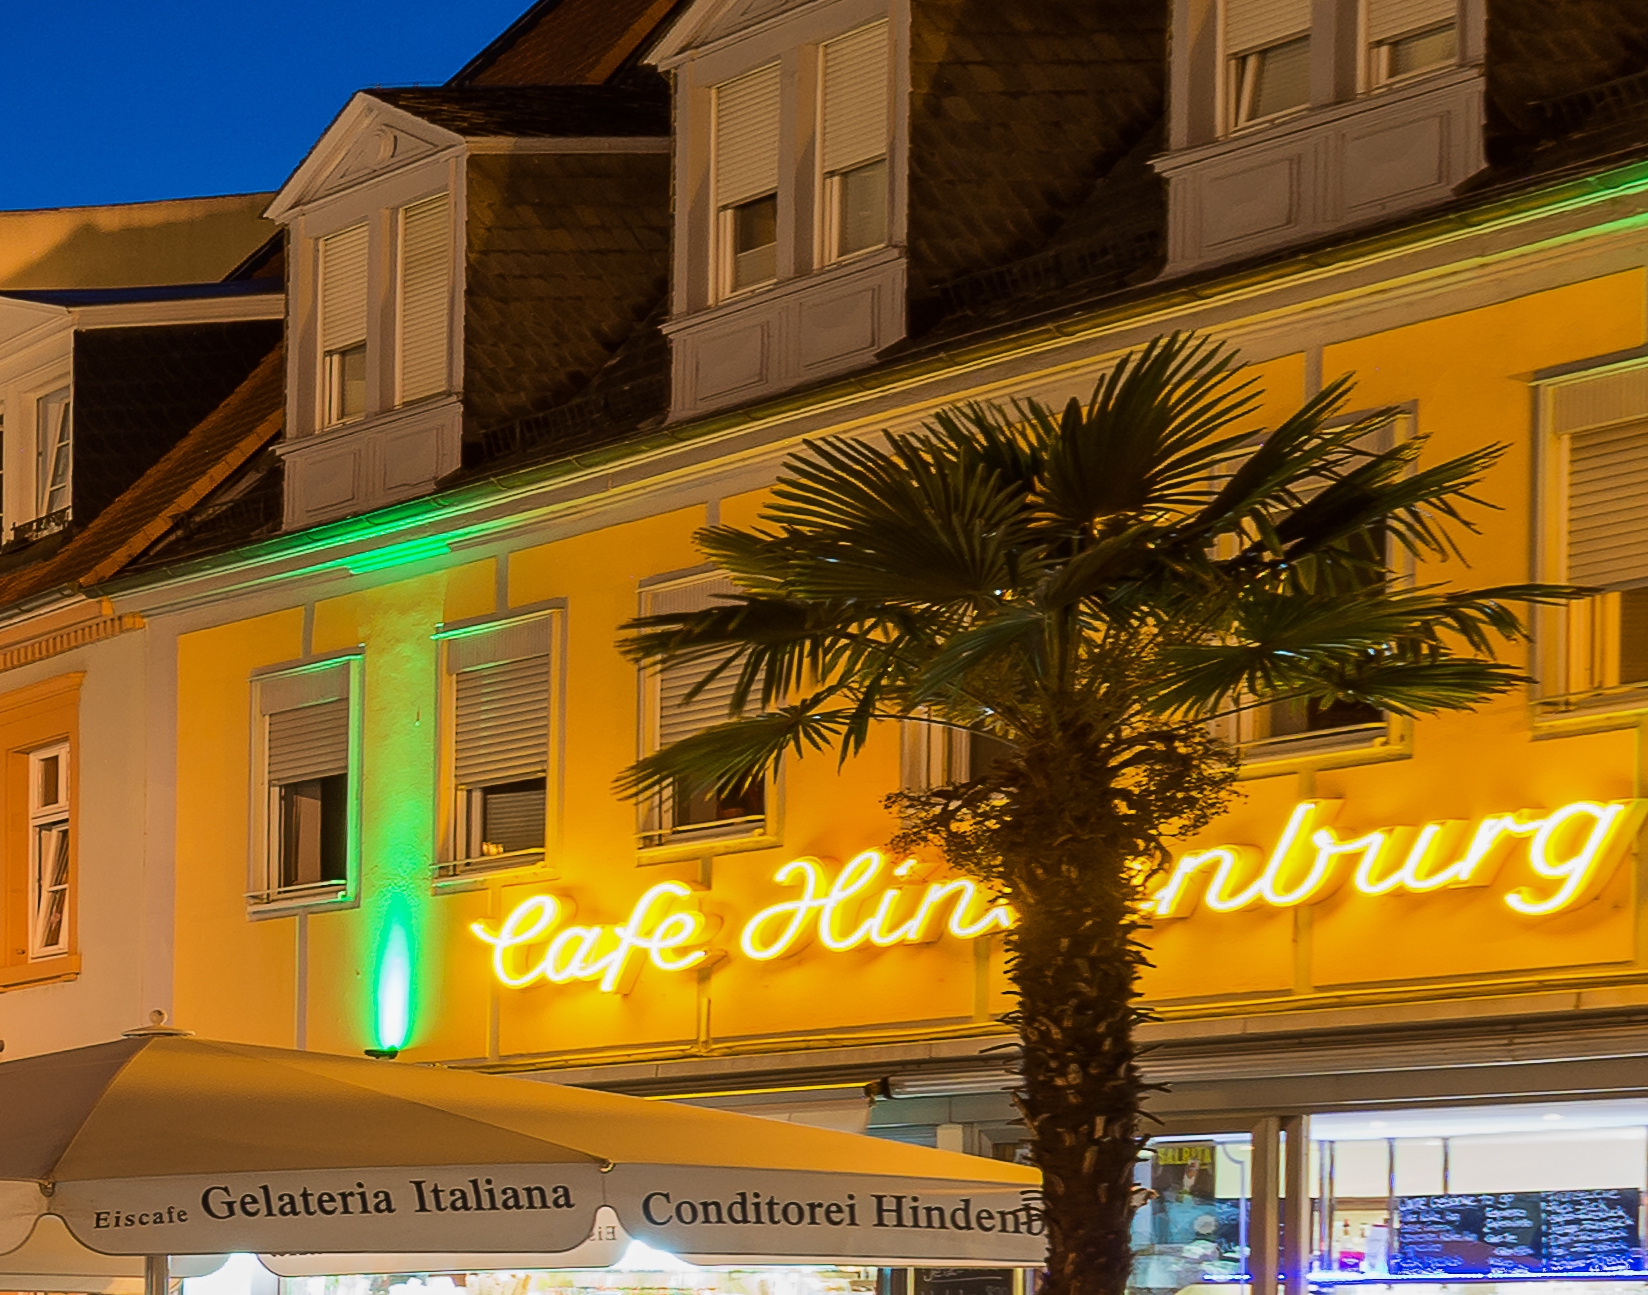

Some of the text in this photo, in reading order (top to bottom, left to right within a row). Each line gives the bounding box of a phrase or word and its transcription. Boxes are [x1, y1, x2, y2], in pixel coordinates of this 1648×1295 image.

[470, 797, 1628, 994] Cafe Hinnburg
[93, 1178, 576, 1230] Eiscafe Gelateria Italiana
[642, 1191, 1045, 1236] Conditorei Hindenb
